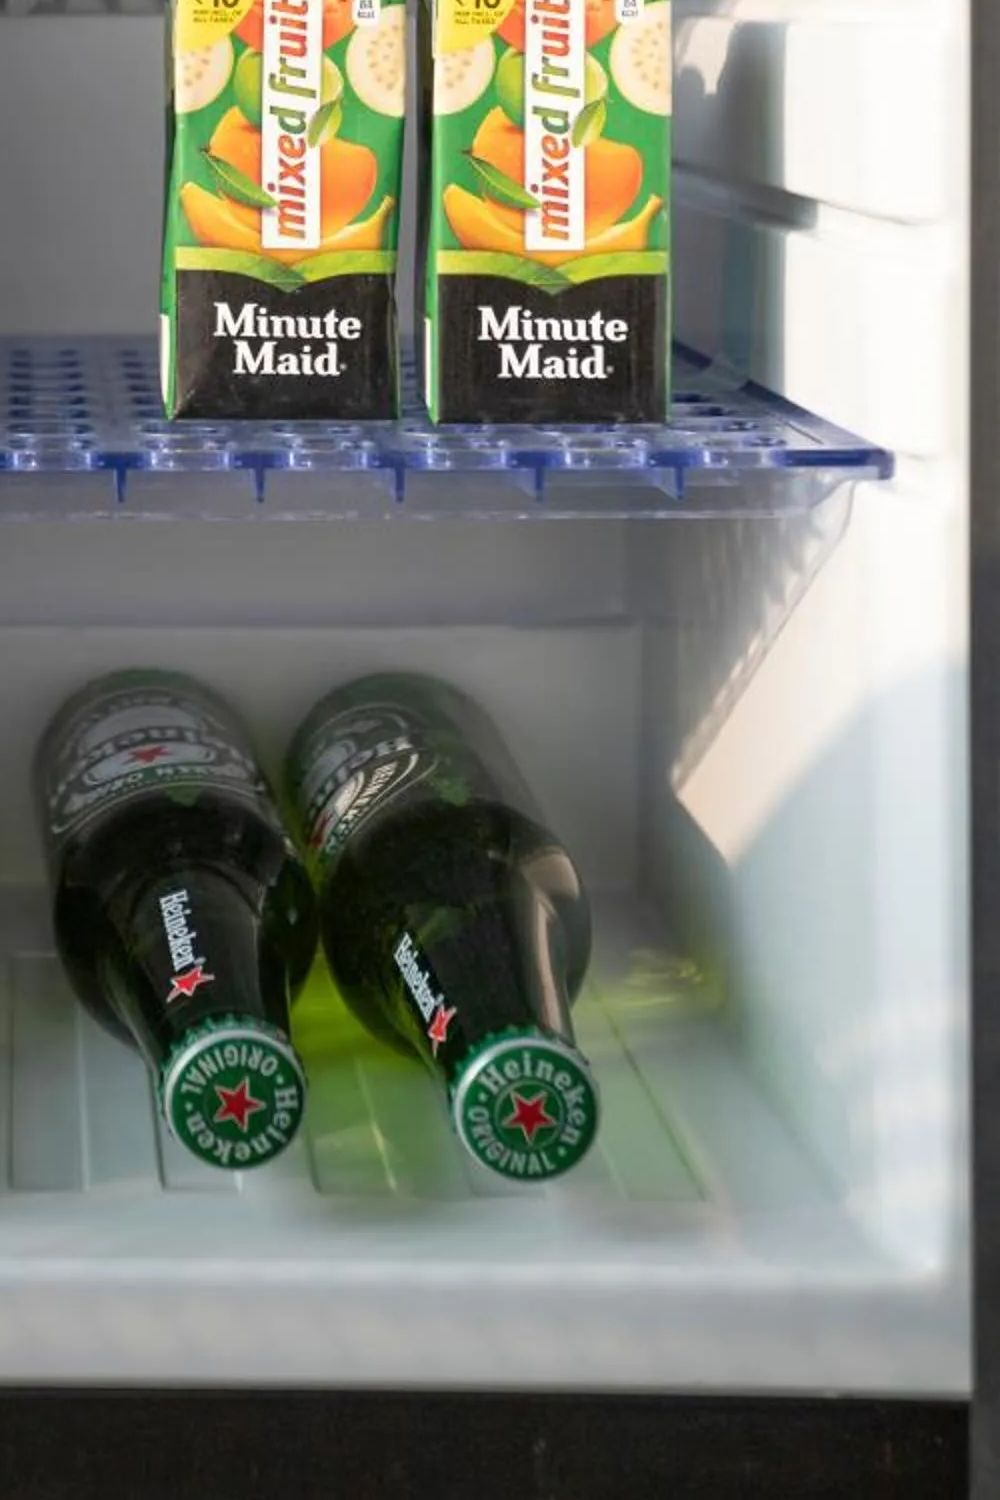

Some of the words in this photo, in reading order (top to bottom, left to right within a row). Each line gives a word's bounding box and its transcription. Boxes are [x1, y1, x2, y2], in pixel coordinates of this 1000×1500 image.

[267, 106, 308, 240] mixed
[531, 106, 571, 241] mixed
[213, 302, 362, 340] Minute
[232, 340, 342, 377] Maid
[477, 305, 629, 342] Minute
[497, 343, 609, 380] Maid
[159, 889, 198, 973] Heineken
[394, 932, 437, 1022] Heineken
[180, 1044, 280, 1095] ORIGINAL
[478, 1055, 587, 1148] Heineken
[186, 1084, 299, 1165] Heineken
[468, 1104, 556, 1175] ORIGINAL
